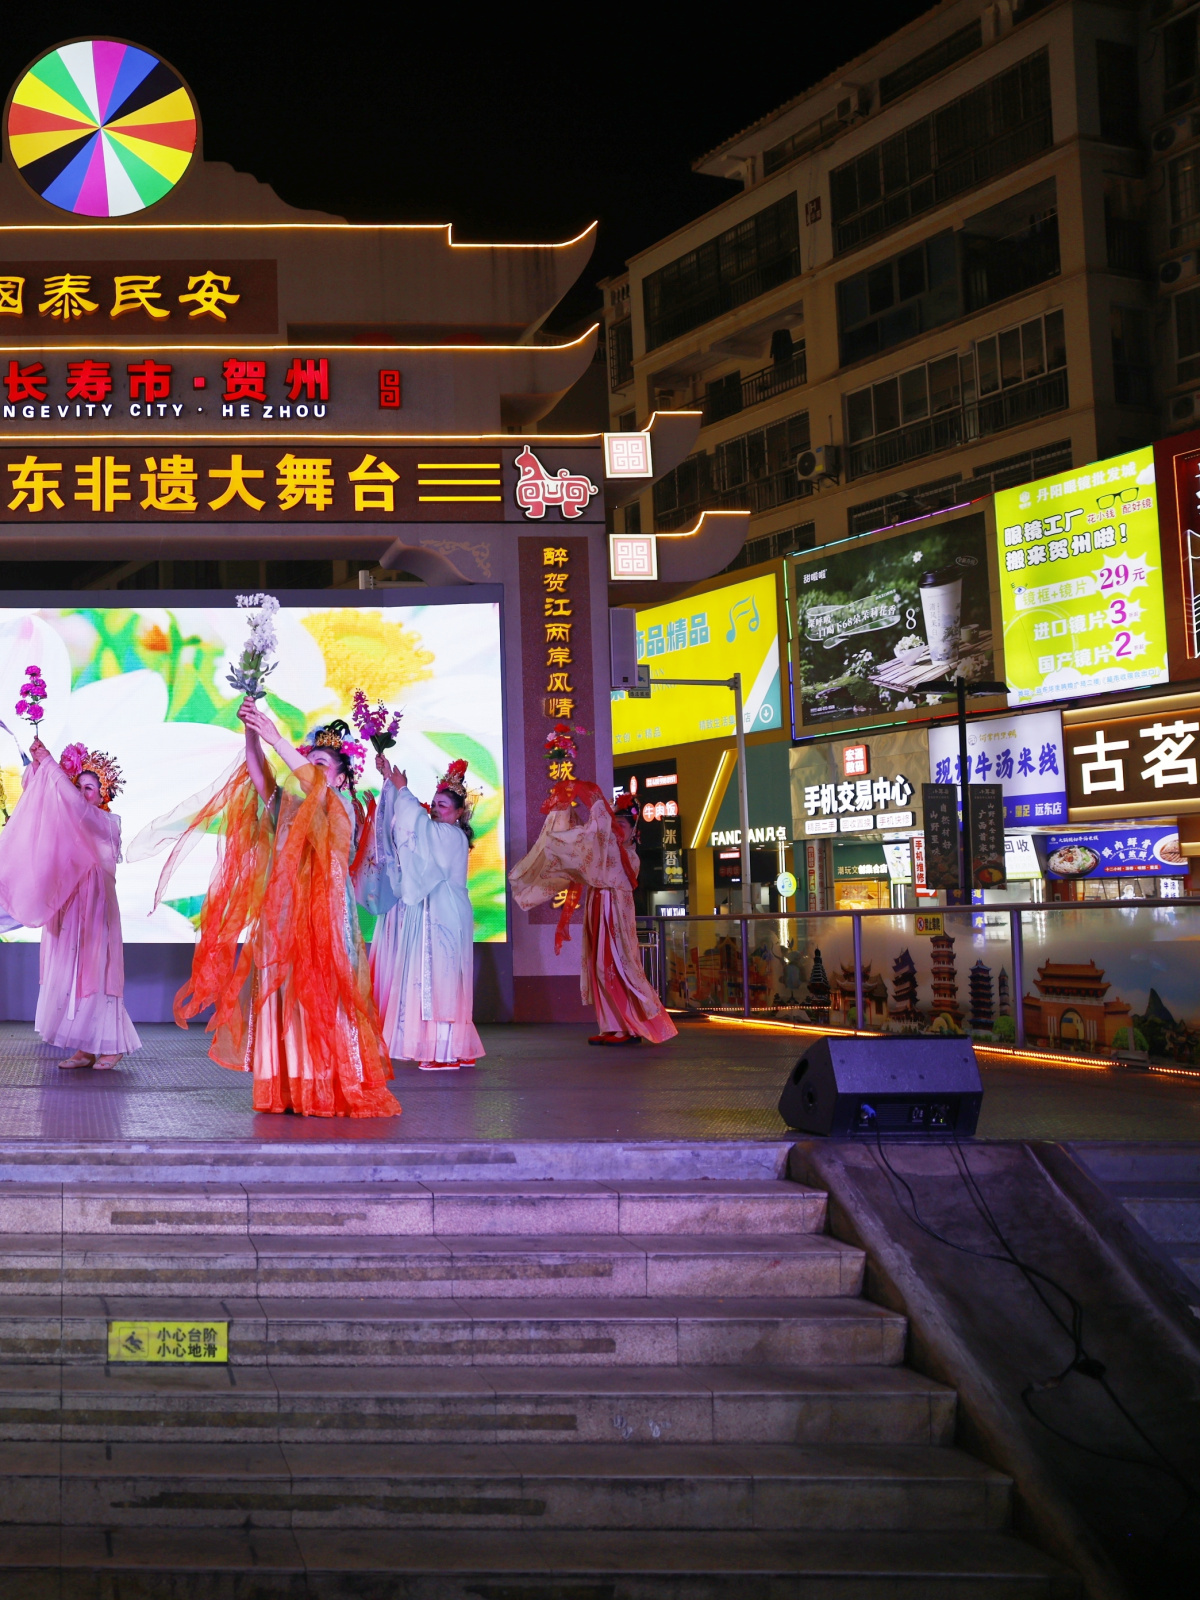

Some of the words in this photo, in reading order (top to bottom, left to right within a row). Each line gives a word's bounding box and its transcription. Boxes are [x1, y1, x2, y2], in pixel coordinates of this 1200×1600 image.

[129, 403, 183, 418] CITY
[222, 404, 251, 418] HE
[263, 405, 327, 419] ZHOU
[1035, 461, 1137, 504] 丹阳眼镜批发城
[1086, 508, 1116, 524] 花小钱
[1121, 497, 1153, 515] 配好镜
[1003, 508, 1084, 547] 眼镜工厂
[803, 569, 827, 584] 甜啦啦
[542, 547, 574, 719] 醉贺江两岸风情
[1033, 614, 1105, 642] 进口镜片
[1109, 599, 1128, 625] 3
[1037, 646, 1111, 674] 国产镜片
[1114, 631, 1132, 658] 2
[1073, 720, 1200, 795] 古茗
[643, 801, 678, 820] 牛肉饭
[804, 775, 912, 815] 手机交易中心
[1034, 802, 1062, 816] 远东店
[711, 826, 787, 846] FANDAN凡点
[914, 839, 925, 883] 手机维修
[156, 1327, 218, 1343] 小心台阶
[156, 1342, 218, 1359] 小心地滑
